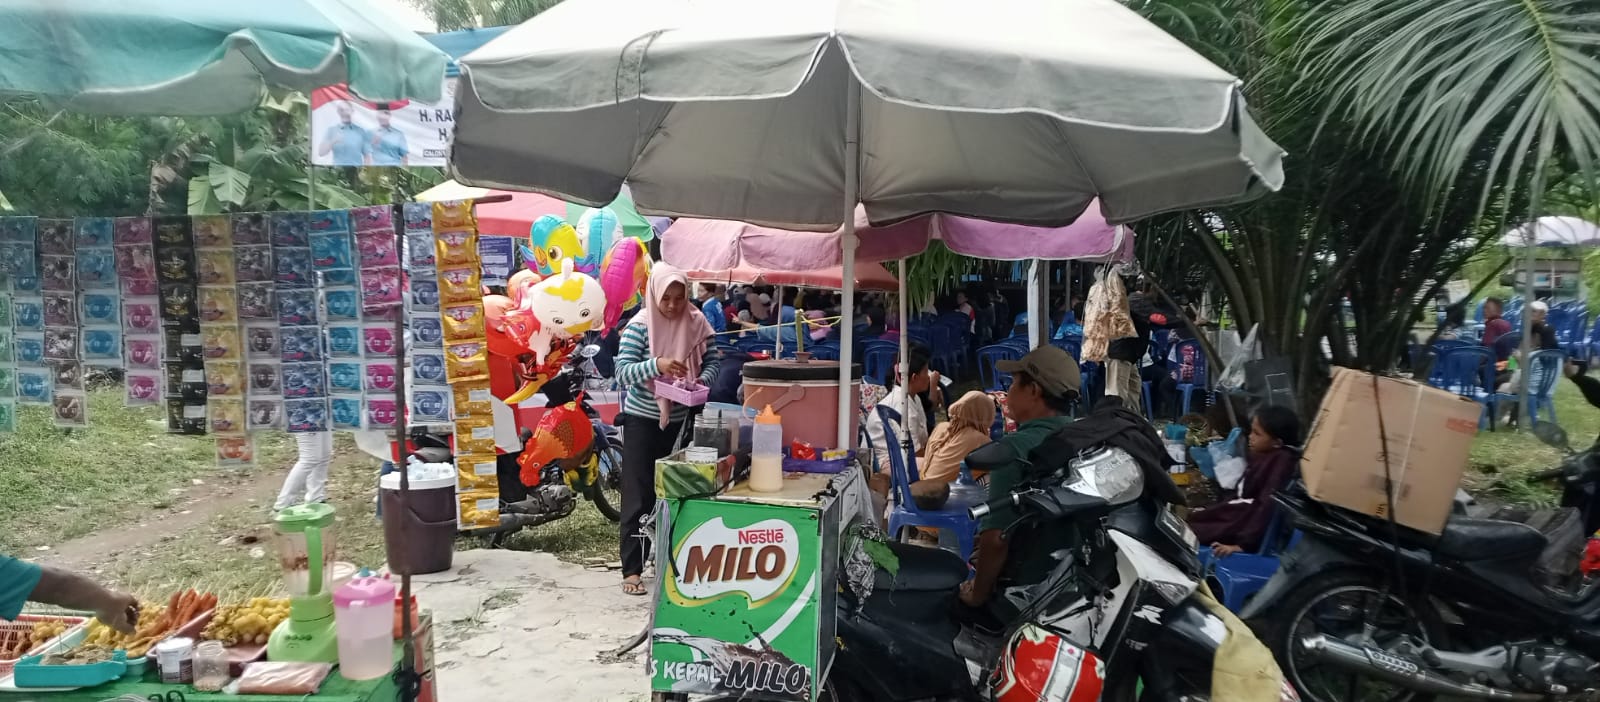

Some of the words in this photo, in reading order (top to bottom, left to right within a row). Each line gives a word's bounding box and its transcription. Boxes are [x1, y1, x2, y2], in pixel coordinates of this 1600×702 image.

[419, 109, 432, 122] H.
[683, 544, 786, 584] MILO
[663, 661, 721, 682] KEPAL
[725, 659, 806, 694] MILO
